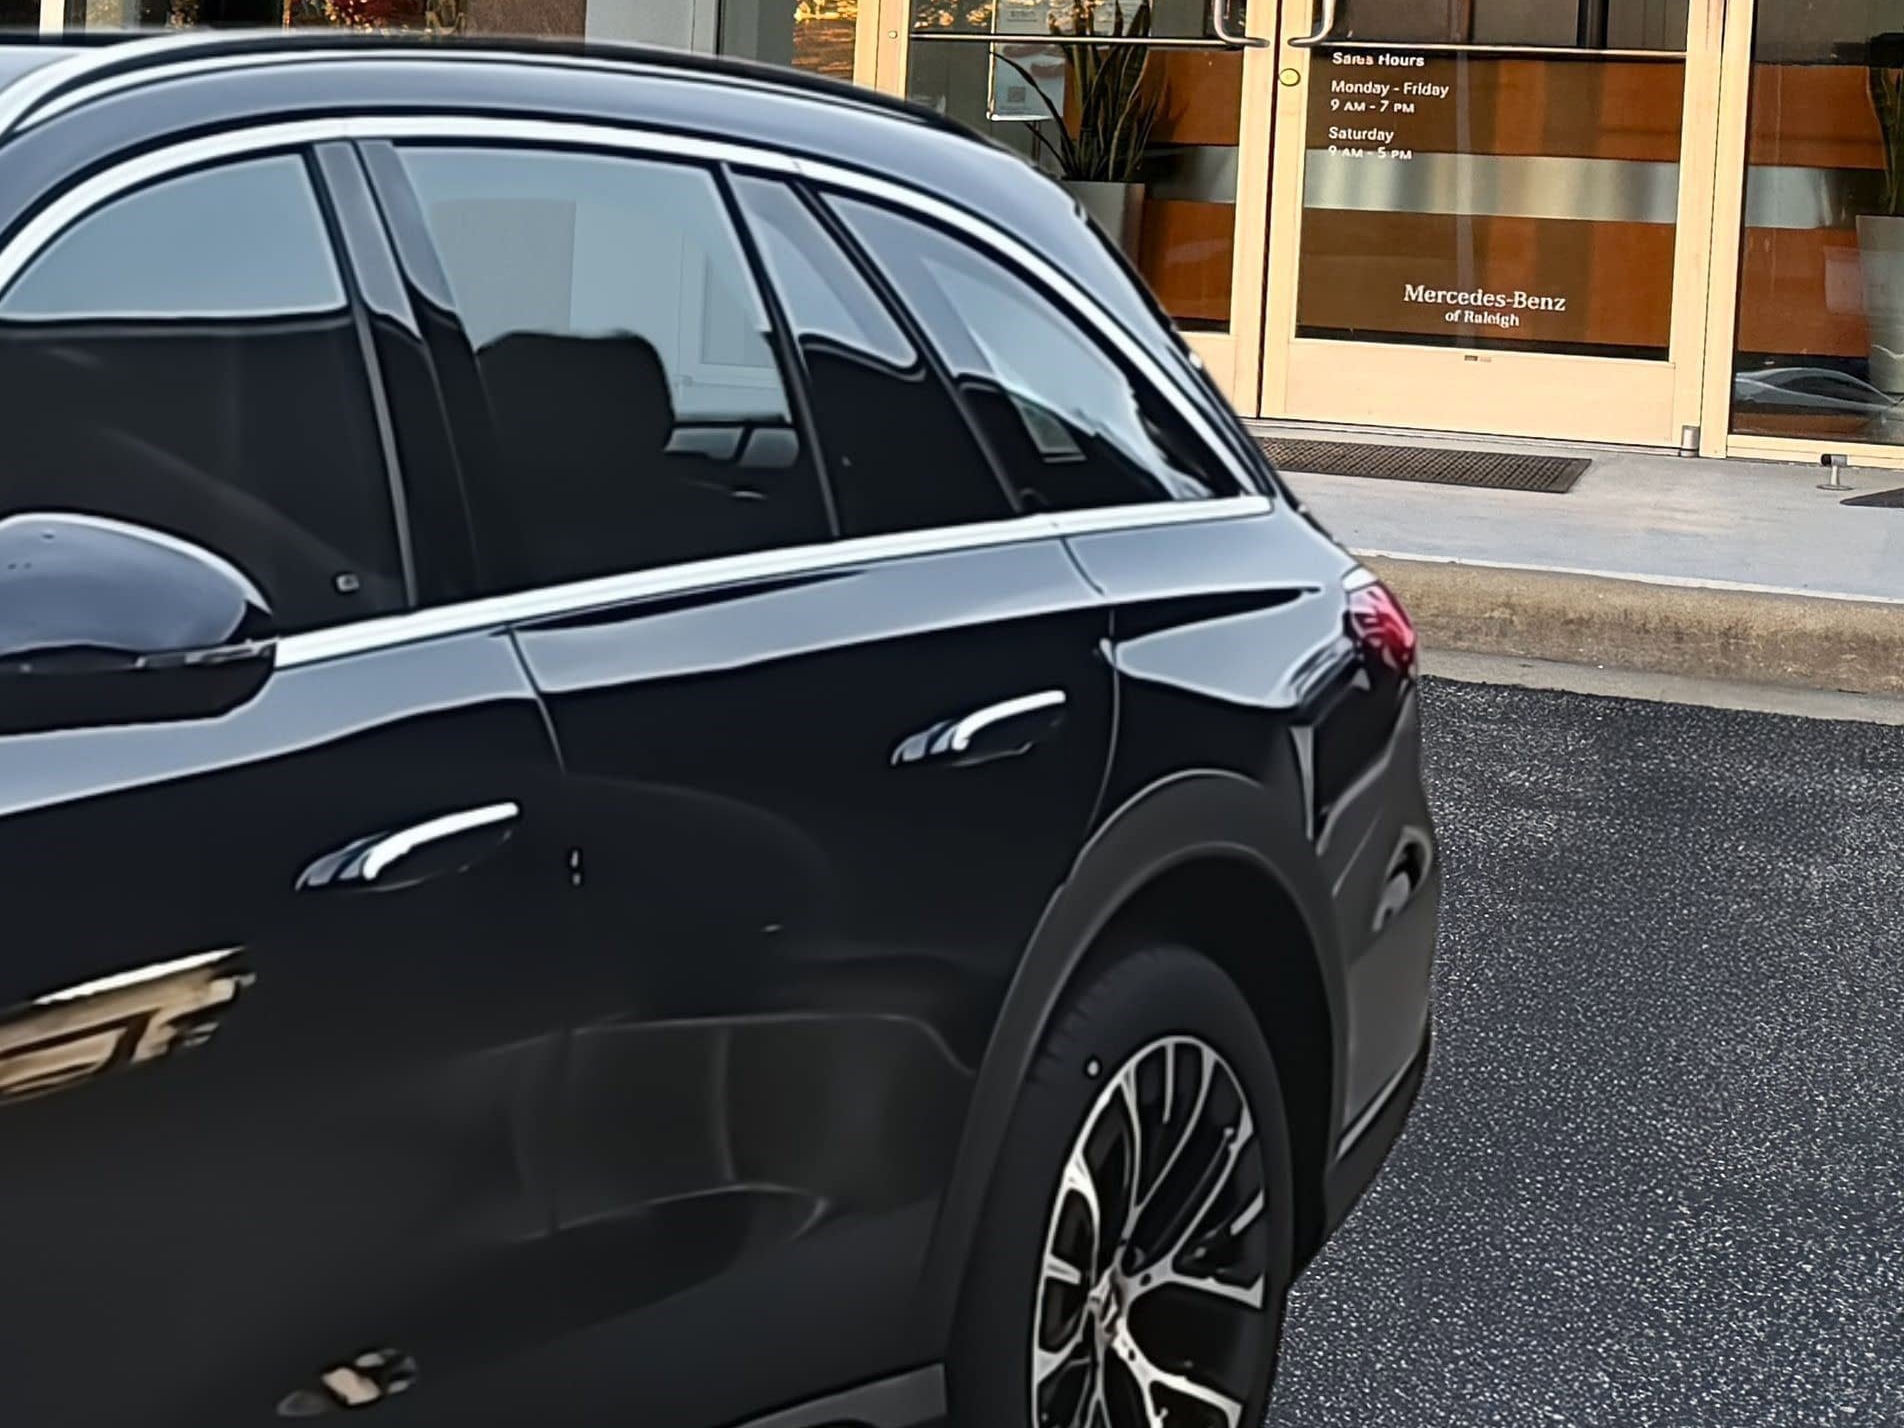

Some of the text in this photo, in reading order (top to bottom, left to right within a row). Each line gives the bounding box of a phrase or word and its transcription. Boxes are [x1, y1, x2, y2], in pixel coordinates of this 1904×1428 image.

[1378, 53, 1425, 67] Hours
[1331, 80, 1390, 97] Monday
[1403, 82, 1449, 99] Friday
[1330, 98, 1340, 111] 9
[1344, 101, 1366, 111] AM
[1380, 100, 1389, 112] 7
[1394, 103, 1415, 113] PM
[1328, 126, 1394, 144] Saturday
[1328, 145, 1337, 157] 9
[1341, 148, 1363, 158] AM
[1377, 146, 1387, 159] 5
[1391, 150, 1412, 160] PM
[1403, 284, 1566, 312] Mercedes-Benz
[1445, 310, 1520, 329] of Raleigh
